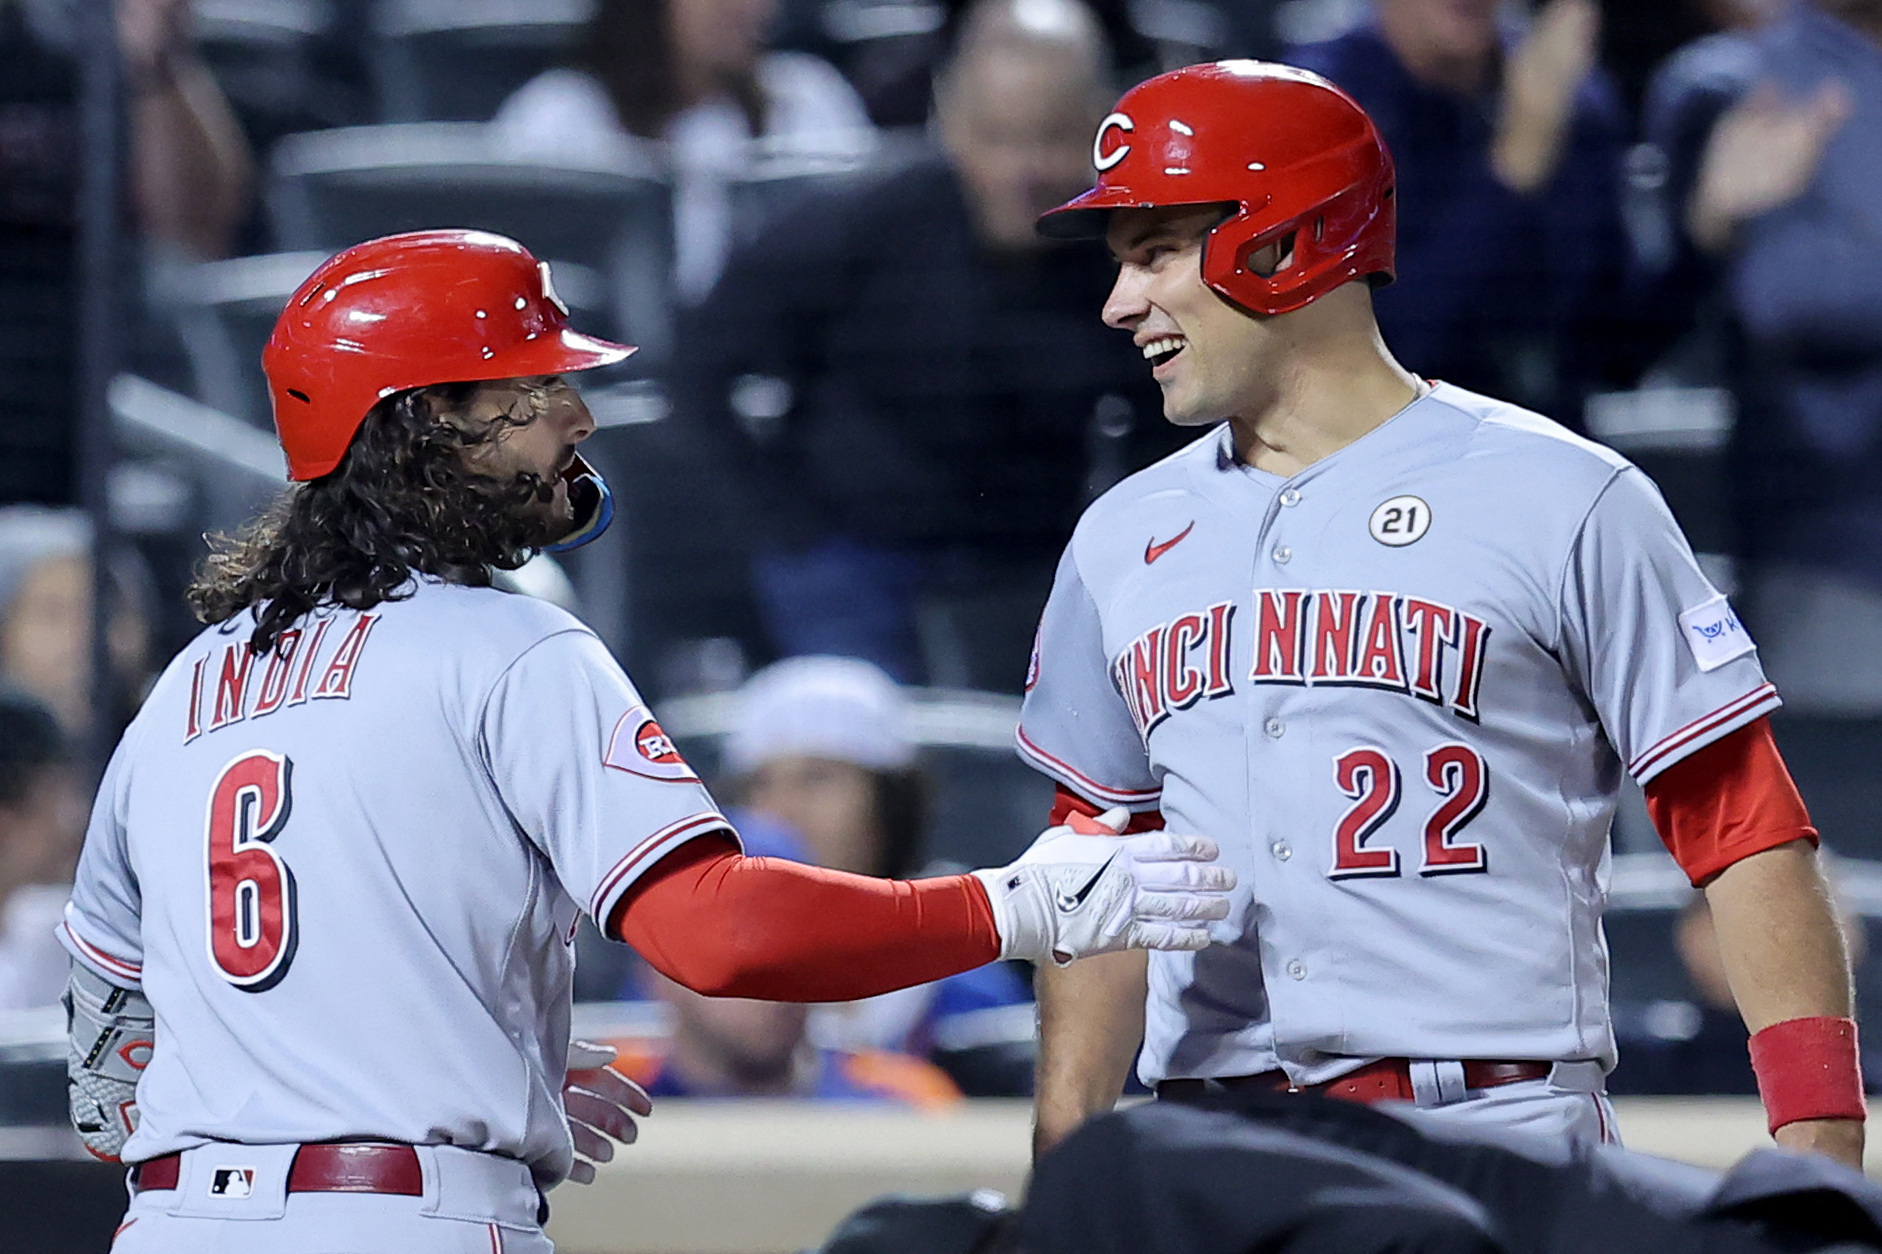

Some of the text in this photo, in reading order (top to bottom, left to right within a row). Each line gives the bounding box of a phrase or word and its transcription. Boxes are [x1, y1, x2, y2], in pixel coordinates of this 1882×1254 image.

[1092, 112, 1135, 172] C
[1382, 506, 1417, 533] 21
[183, 612, 382, 746] INDIA
[203, 748, 300, 993] 6
[1327, 741, 1490, 882] 22
